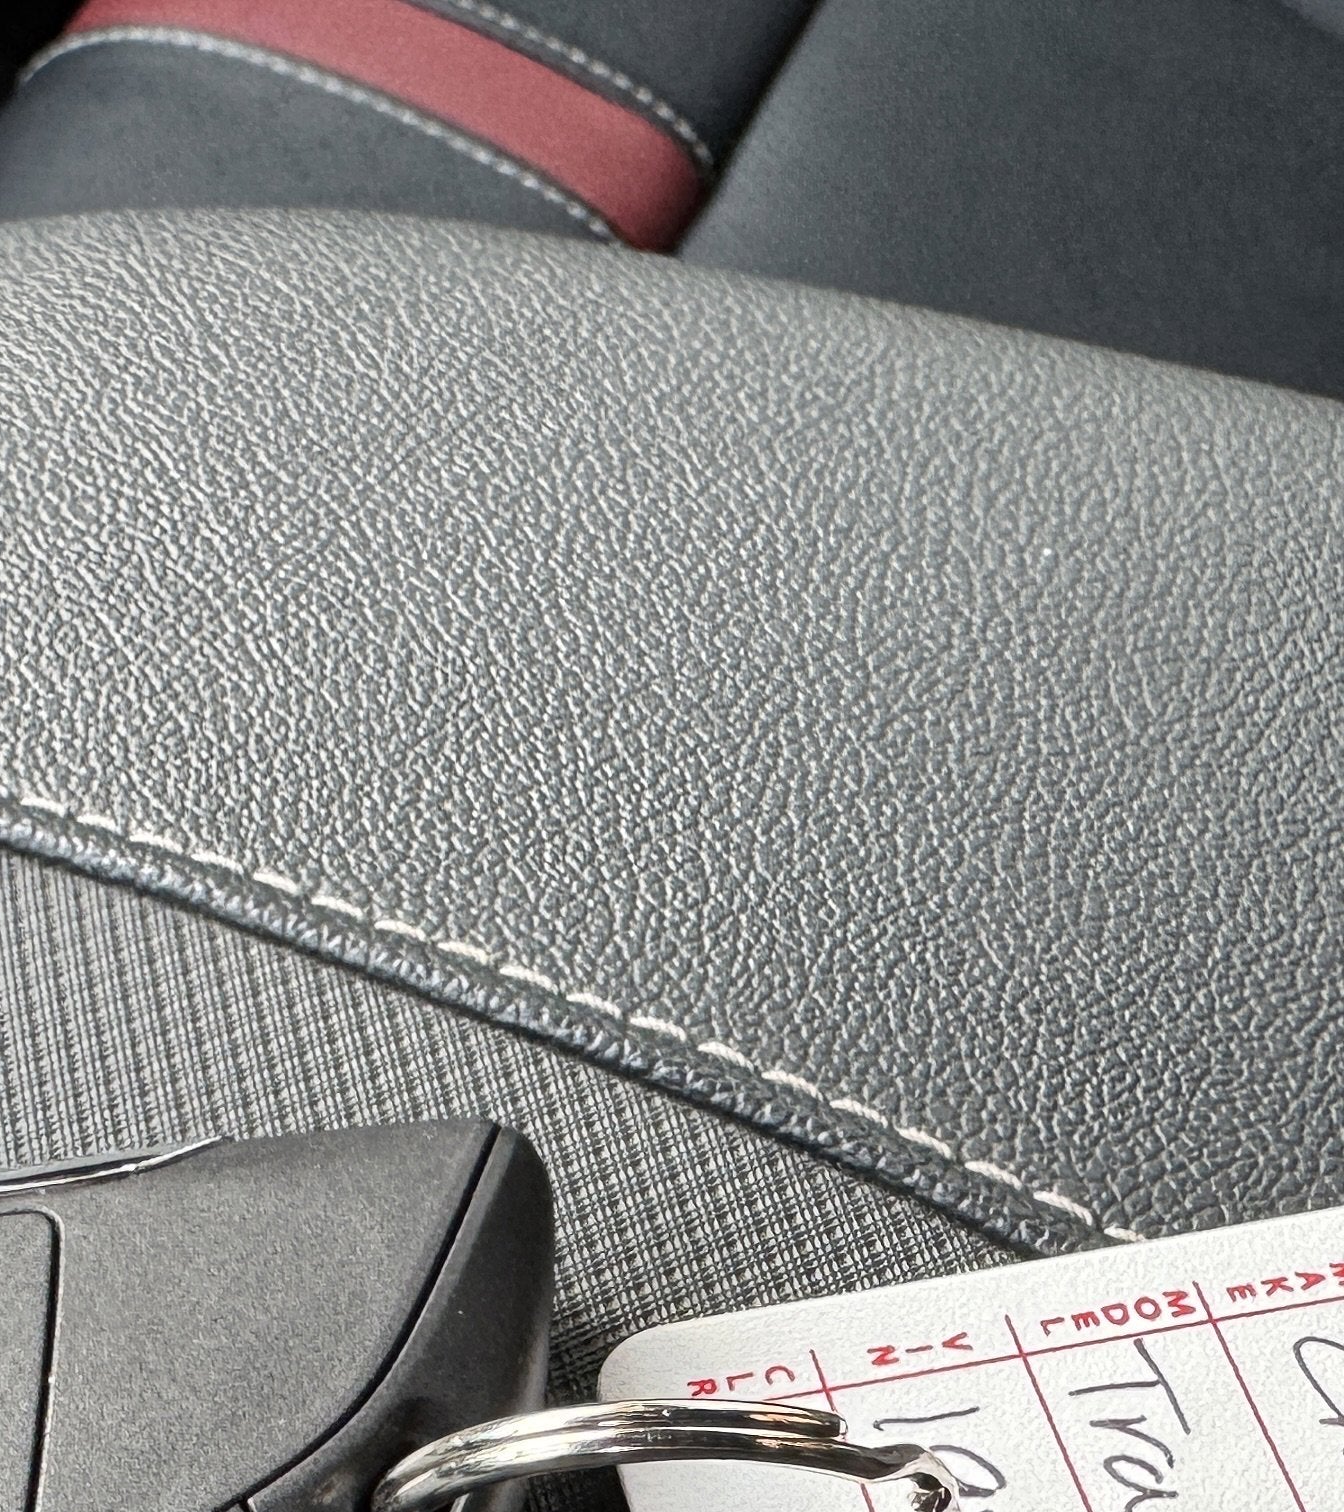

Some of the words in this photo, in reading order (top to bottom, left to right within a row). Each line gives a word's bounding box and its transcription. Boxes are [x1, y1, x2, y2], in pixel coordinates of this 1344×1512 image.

[1042, 1290, 1196, 1335] MODEL
[866, 1331, 974, 1367] VIN
[687, 1364, 795, 1397] CLR
